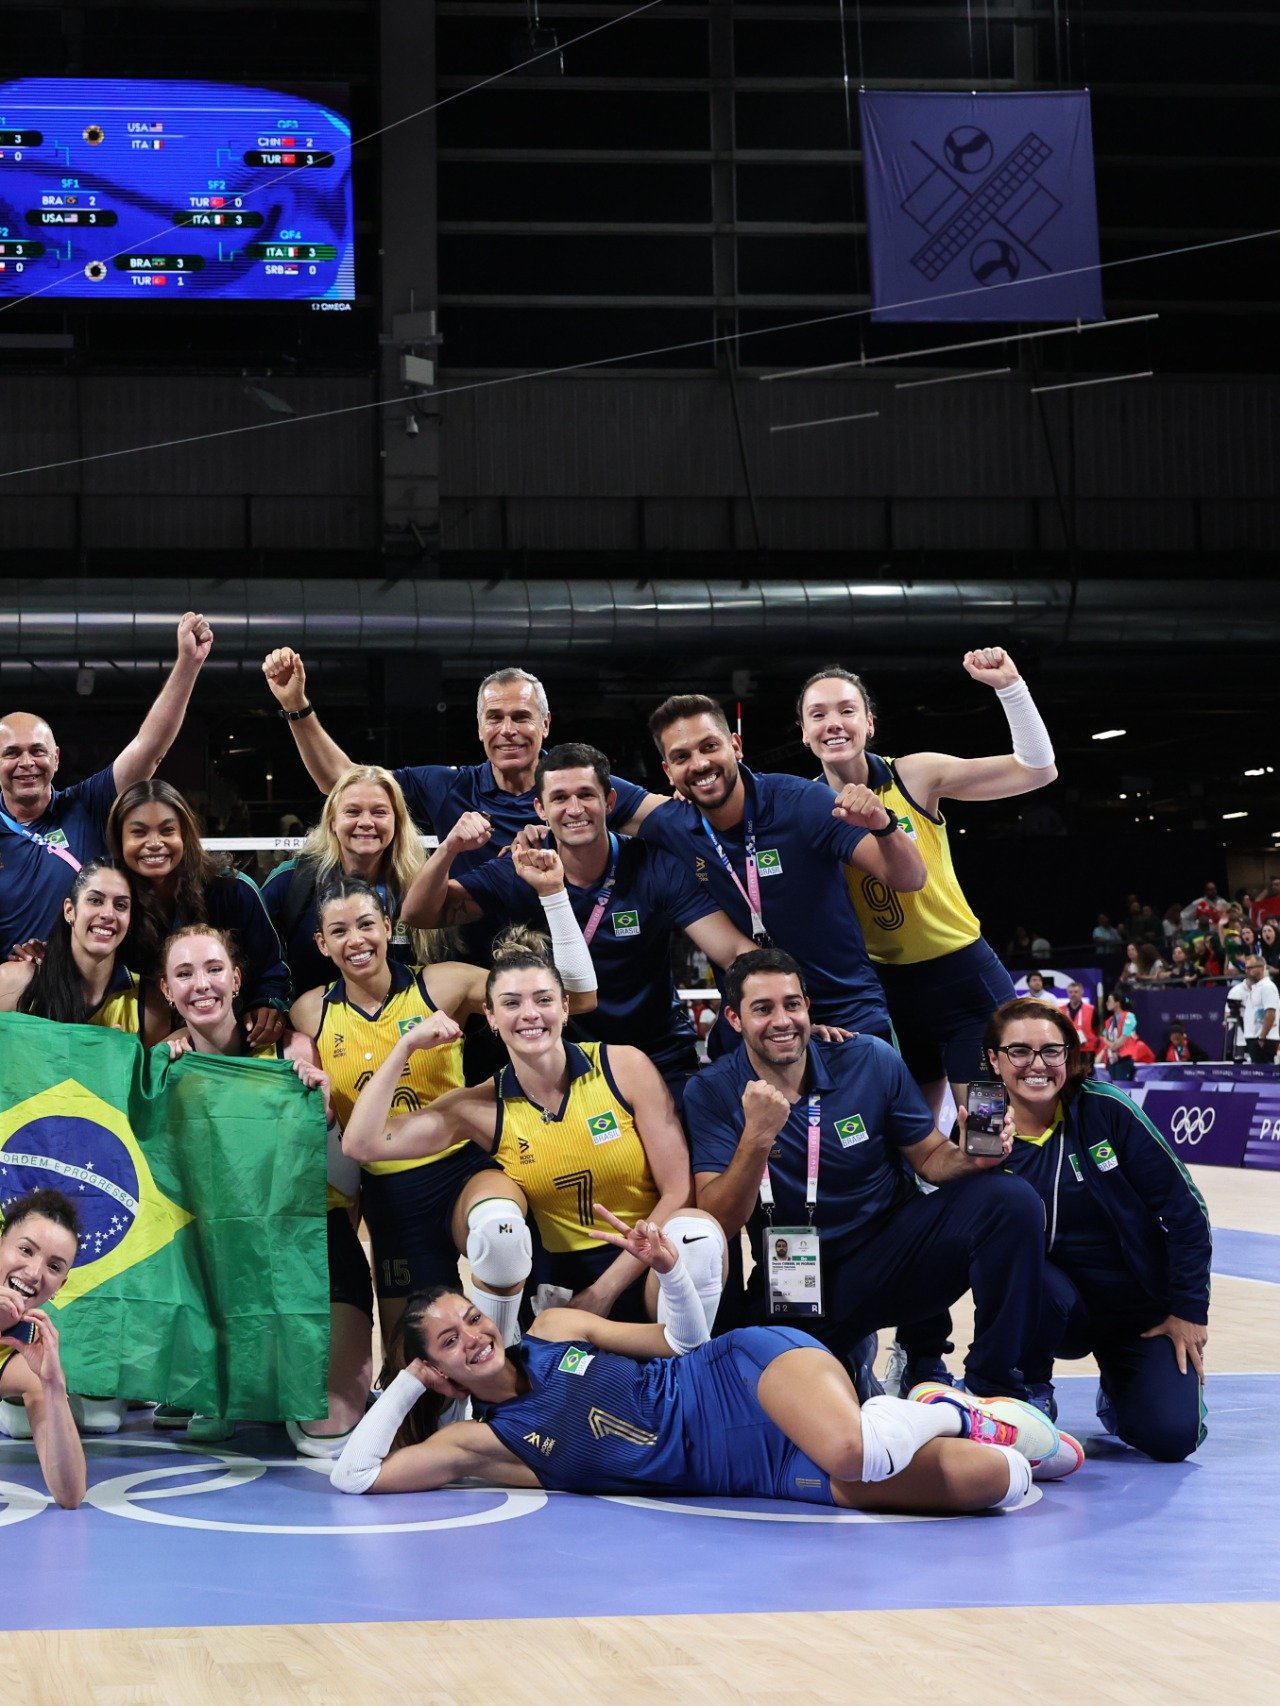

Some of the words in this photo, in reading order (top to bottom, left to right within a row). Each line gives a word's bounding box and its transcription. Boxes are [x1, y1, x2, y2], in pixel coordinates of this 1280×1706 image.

[127, 122, 149, 132] USA
[277, 120, 299, 128] QF3
[14, 134, 22, 144] 3
[258, 138, 280, 146] CHN
[306, 138, 313, 147] 2
[132, 140, 149, 149] ITA
[14, 152, 22, 161] 0
[261, 154, 281, 164] TUR
[306, 155, 314, 164] 3
[61, 178, 80, 188] SF1
[208, 180, 226, 190] SF2
[42, 196, 64, 205] BRA
[89, 196, 96, 206] 2
[190, 197, 210, 206] TUR
[235, 198, 242, 208] 0
[42, 214, 64, 223] USA
[89, 214, 96, 224] 3
[192, 215, 210, 224] ITA
[236, 216, 242, 225] 3
[280, 230, 302, 240] QF4
[16, 245, 23, 254] 3
[266, 248, 284, 257] ITA
[309, 248, 316, 257] 3
[16, 262, 24, 272] 0
[130, 258, 152, 268] BRA
[176, 258, 184, 268] 3
[265, 265, 284, 274] SRB
[309, 266, 316, 275] 0
[131, 276, 152, 286] TUR
[178, 276, 184, 286] 1
[320, 303, 352, 311] OMEGA
[861, 875, 904, 931] 9
[615, 926, 640, 936] BRASIL
[594, 1130, 620, 1145] BRASIL
[3, 1154, 48, 1166] ORDEM
[54, 1162, 61, 1170] E
[64, 1165, 134, 1208] PROGRESSO
[553, 1169, 594, 1226] 7
[382, 1258, 410, 1286] 15
[588, 1406, 658, 1446] 1
